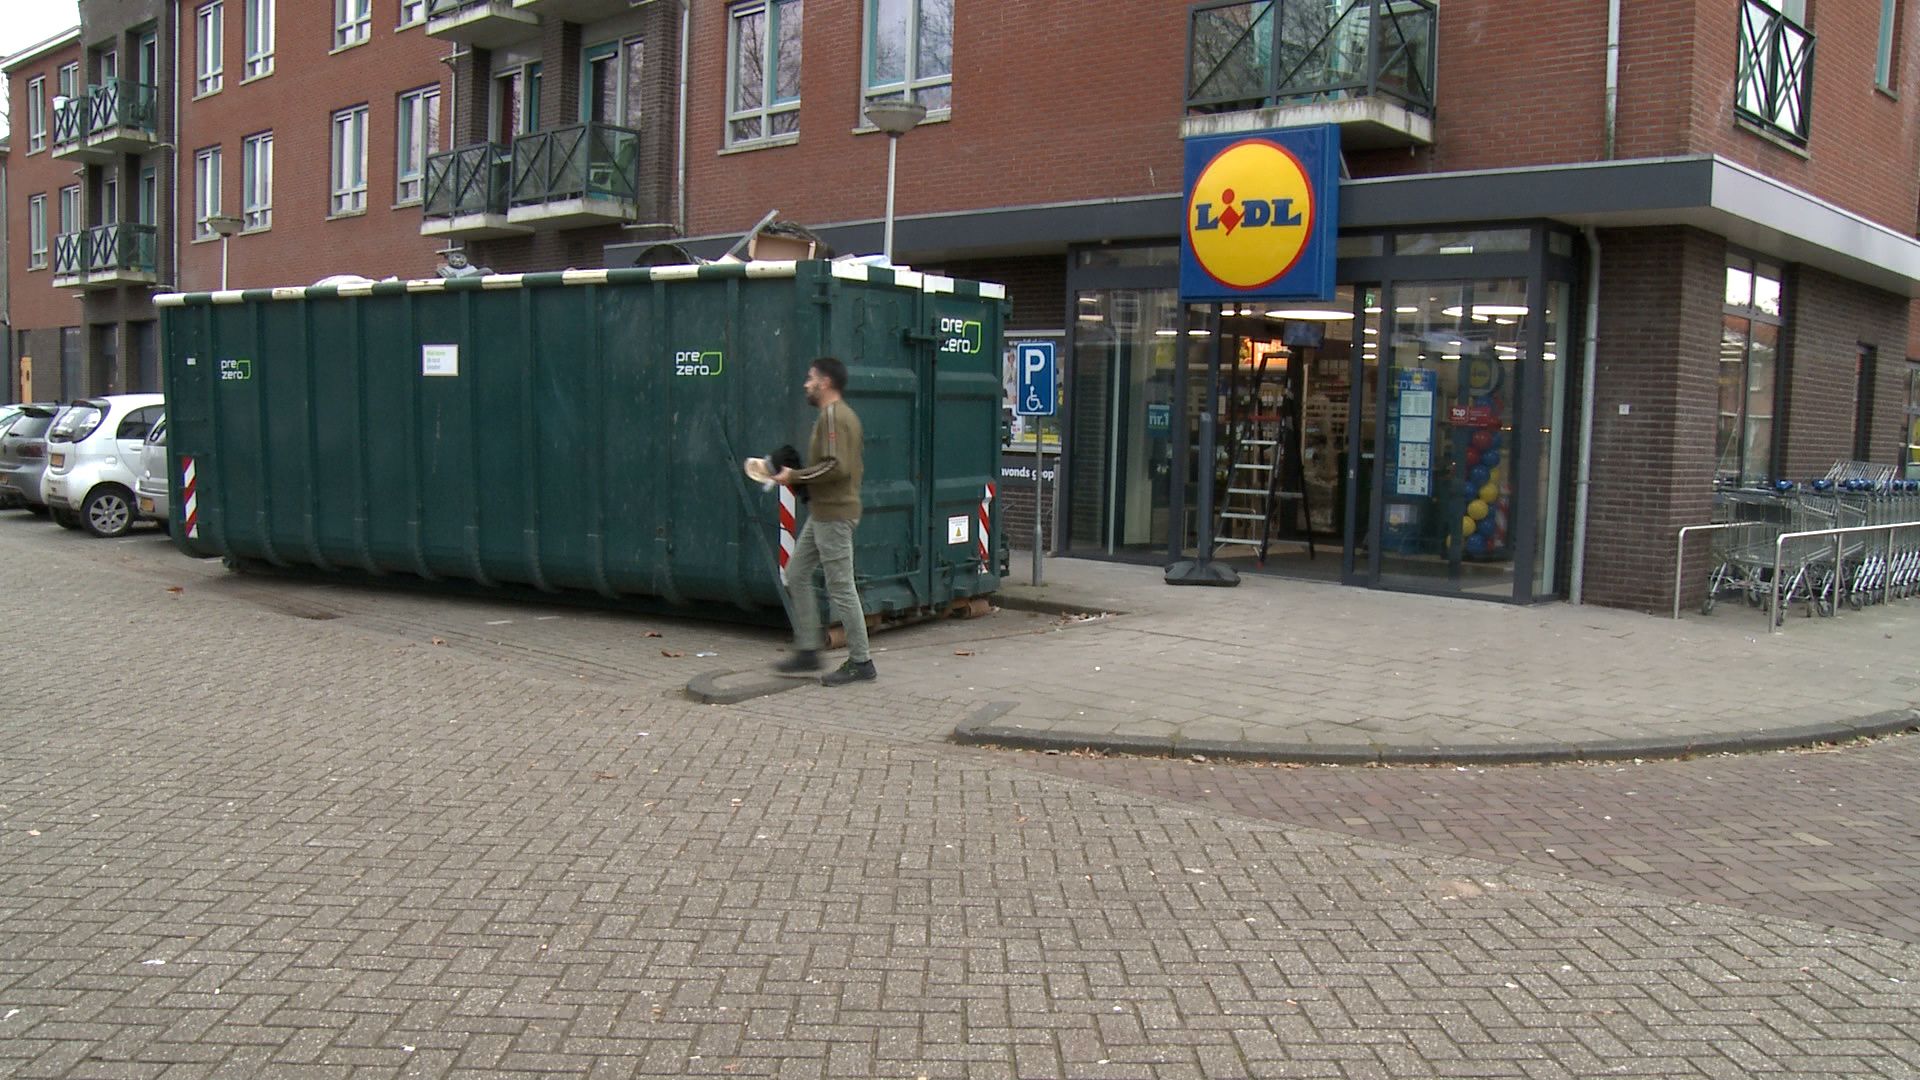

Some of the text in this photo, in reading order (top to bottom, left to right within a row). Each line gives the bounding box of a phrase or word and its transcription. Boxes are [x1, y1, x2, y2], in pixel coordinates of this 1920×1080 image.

[676, 351, 700, 364] pre
[221, 359, 237, 370] pre
[676, 364, 710, 376] zero
[1025, 349, 1046, 385] P
[221, 370, 243, 380] zero
